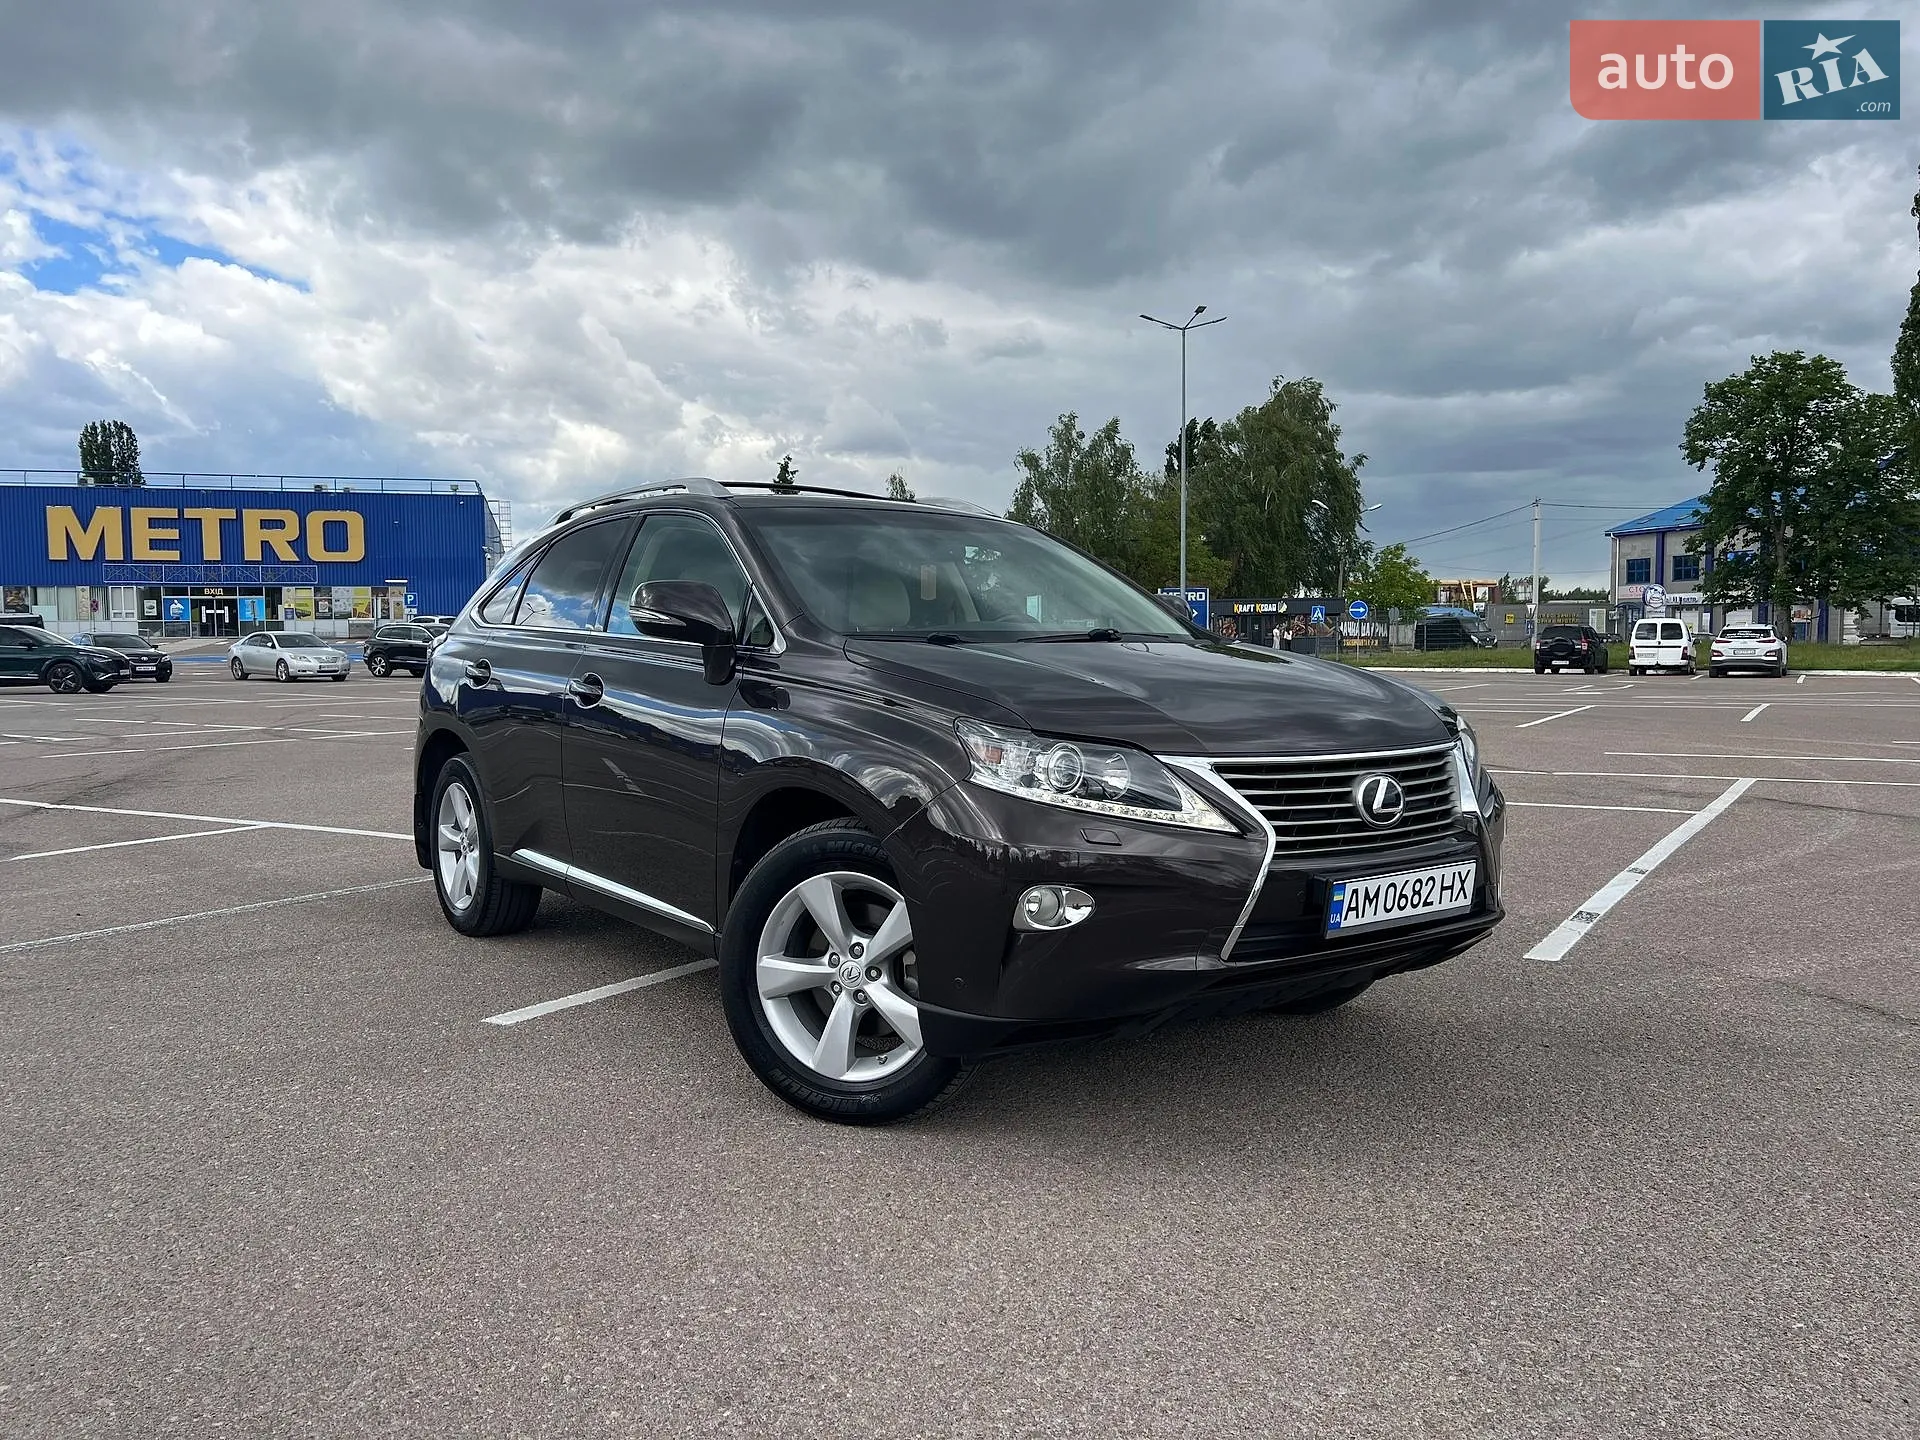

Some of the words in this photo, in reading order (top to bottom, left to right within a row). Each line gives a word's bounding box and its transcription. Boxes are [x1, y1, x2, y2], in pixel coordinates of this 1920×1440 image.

[46, 505, 365, 562] METRO
[204, 588, 224, 596] ВХІД
[407, 595, 414, 604] P
[1234, 603, 1255, 614] KRAFT
[1330, 914, 1341, 924] UA
